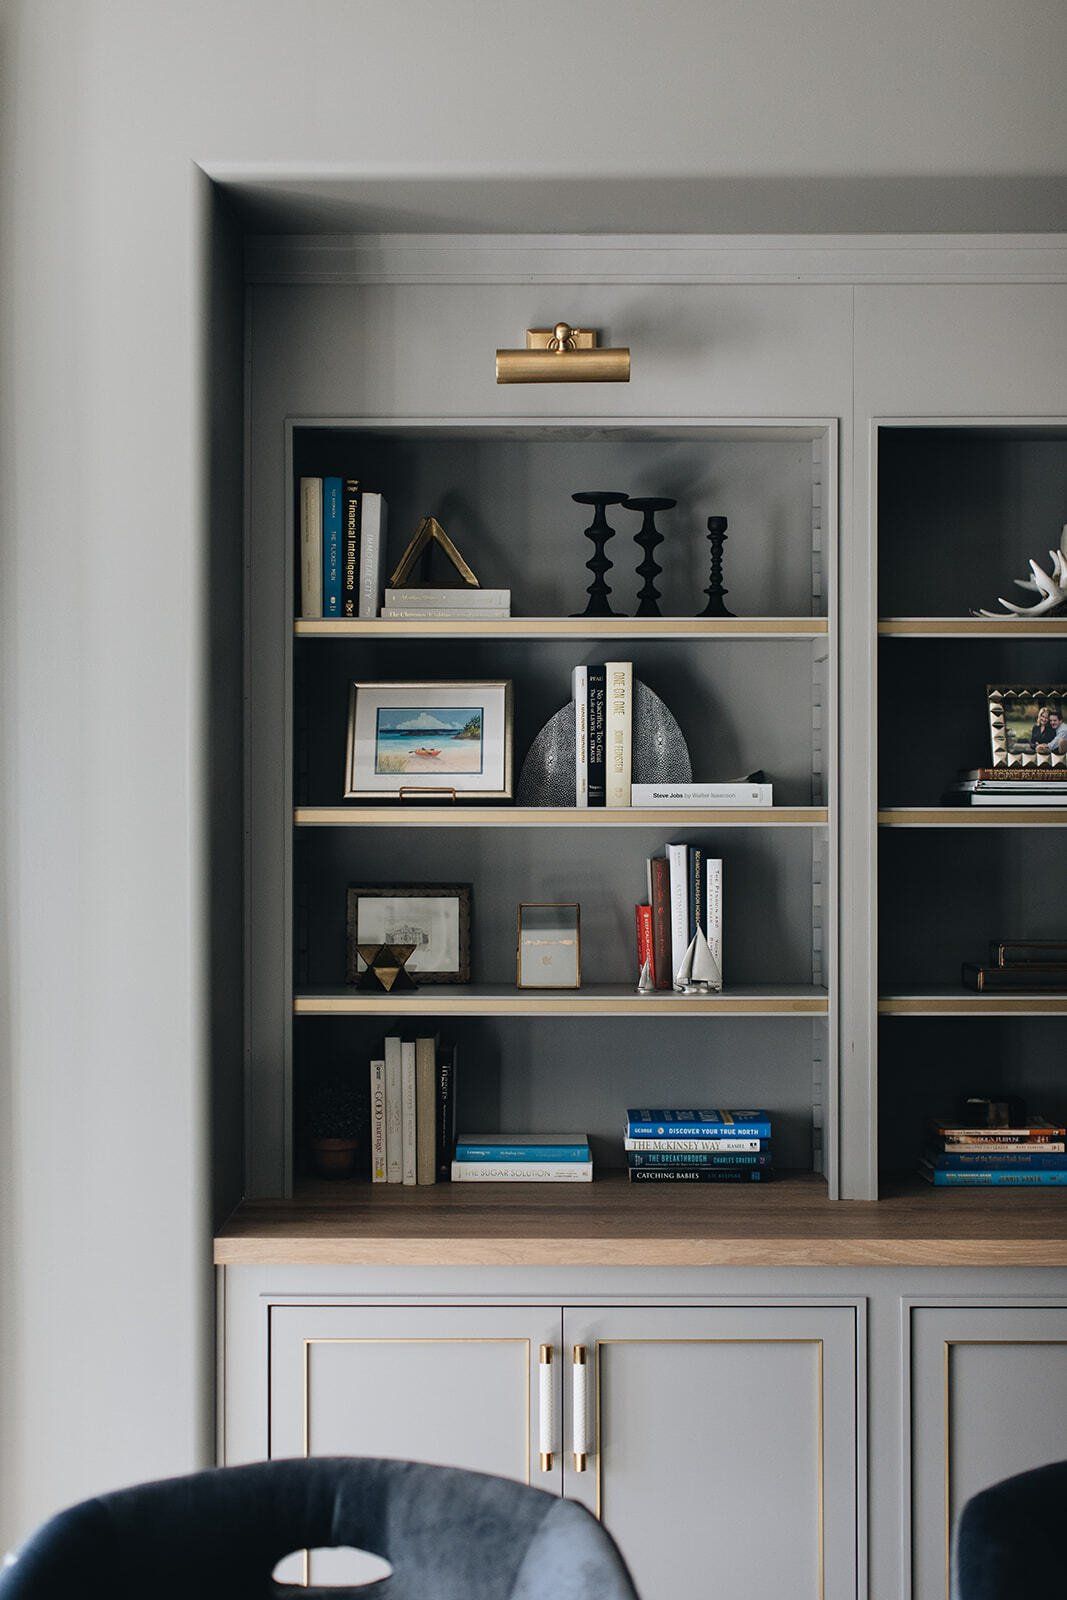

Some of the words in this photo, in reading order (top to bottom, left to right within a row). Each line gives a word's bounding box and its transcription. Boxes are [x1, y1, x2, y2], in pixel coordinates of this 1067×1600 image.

[347, 499, 357, 539] Financial
[366, 534, 375, 578] IMMORTAL
[345, 540, 357, 591] Intelligence
[365, 579, 373, 600] CITY
[613, 671, 625, 686] ONE
[596, 689, 604, 700] No
[613, 687, 625, 699] ON
[596, 700, 604, 730] Sacrifice
[613, 700, 625, 715] ONE
[596, 731, 604, 743] Too
[375, 1091, 383, 1121] GOOD
[374, 1121, 383, 1153] marriage
[669, 1127, 700, 1135] DISCOVER
[631, 1141, 651, 1150] THE
[653, 1141, 700, 1151] McKINSEY
[701, 1141, 721, 1151] WAY
[648, 1154, 660, 1163] THE
[661, 1154, 708, 1163] BREAKTHROUGH
[480, 1169, 509, 1177] SUGAR
[511, 1169, 551, 1177] SOLUTION
[636, 1172, 675, 1180] CATCHING
[676, 1172, 699, 1180] BABIES
